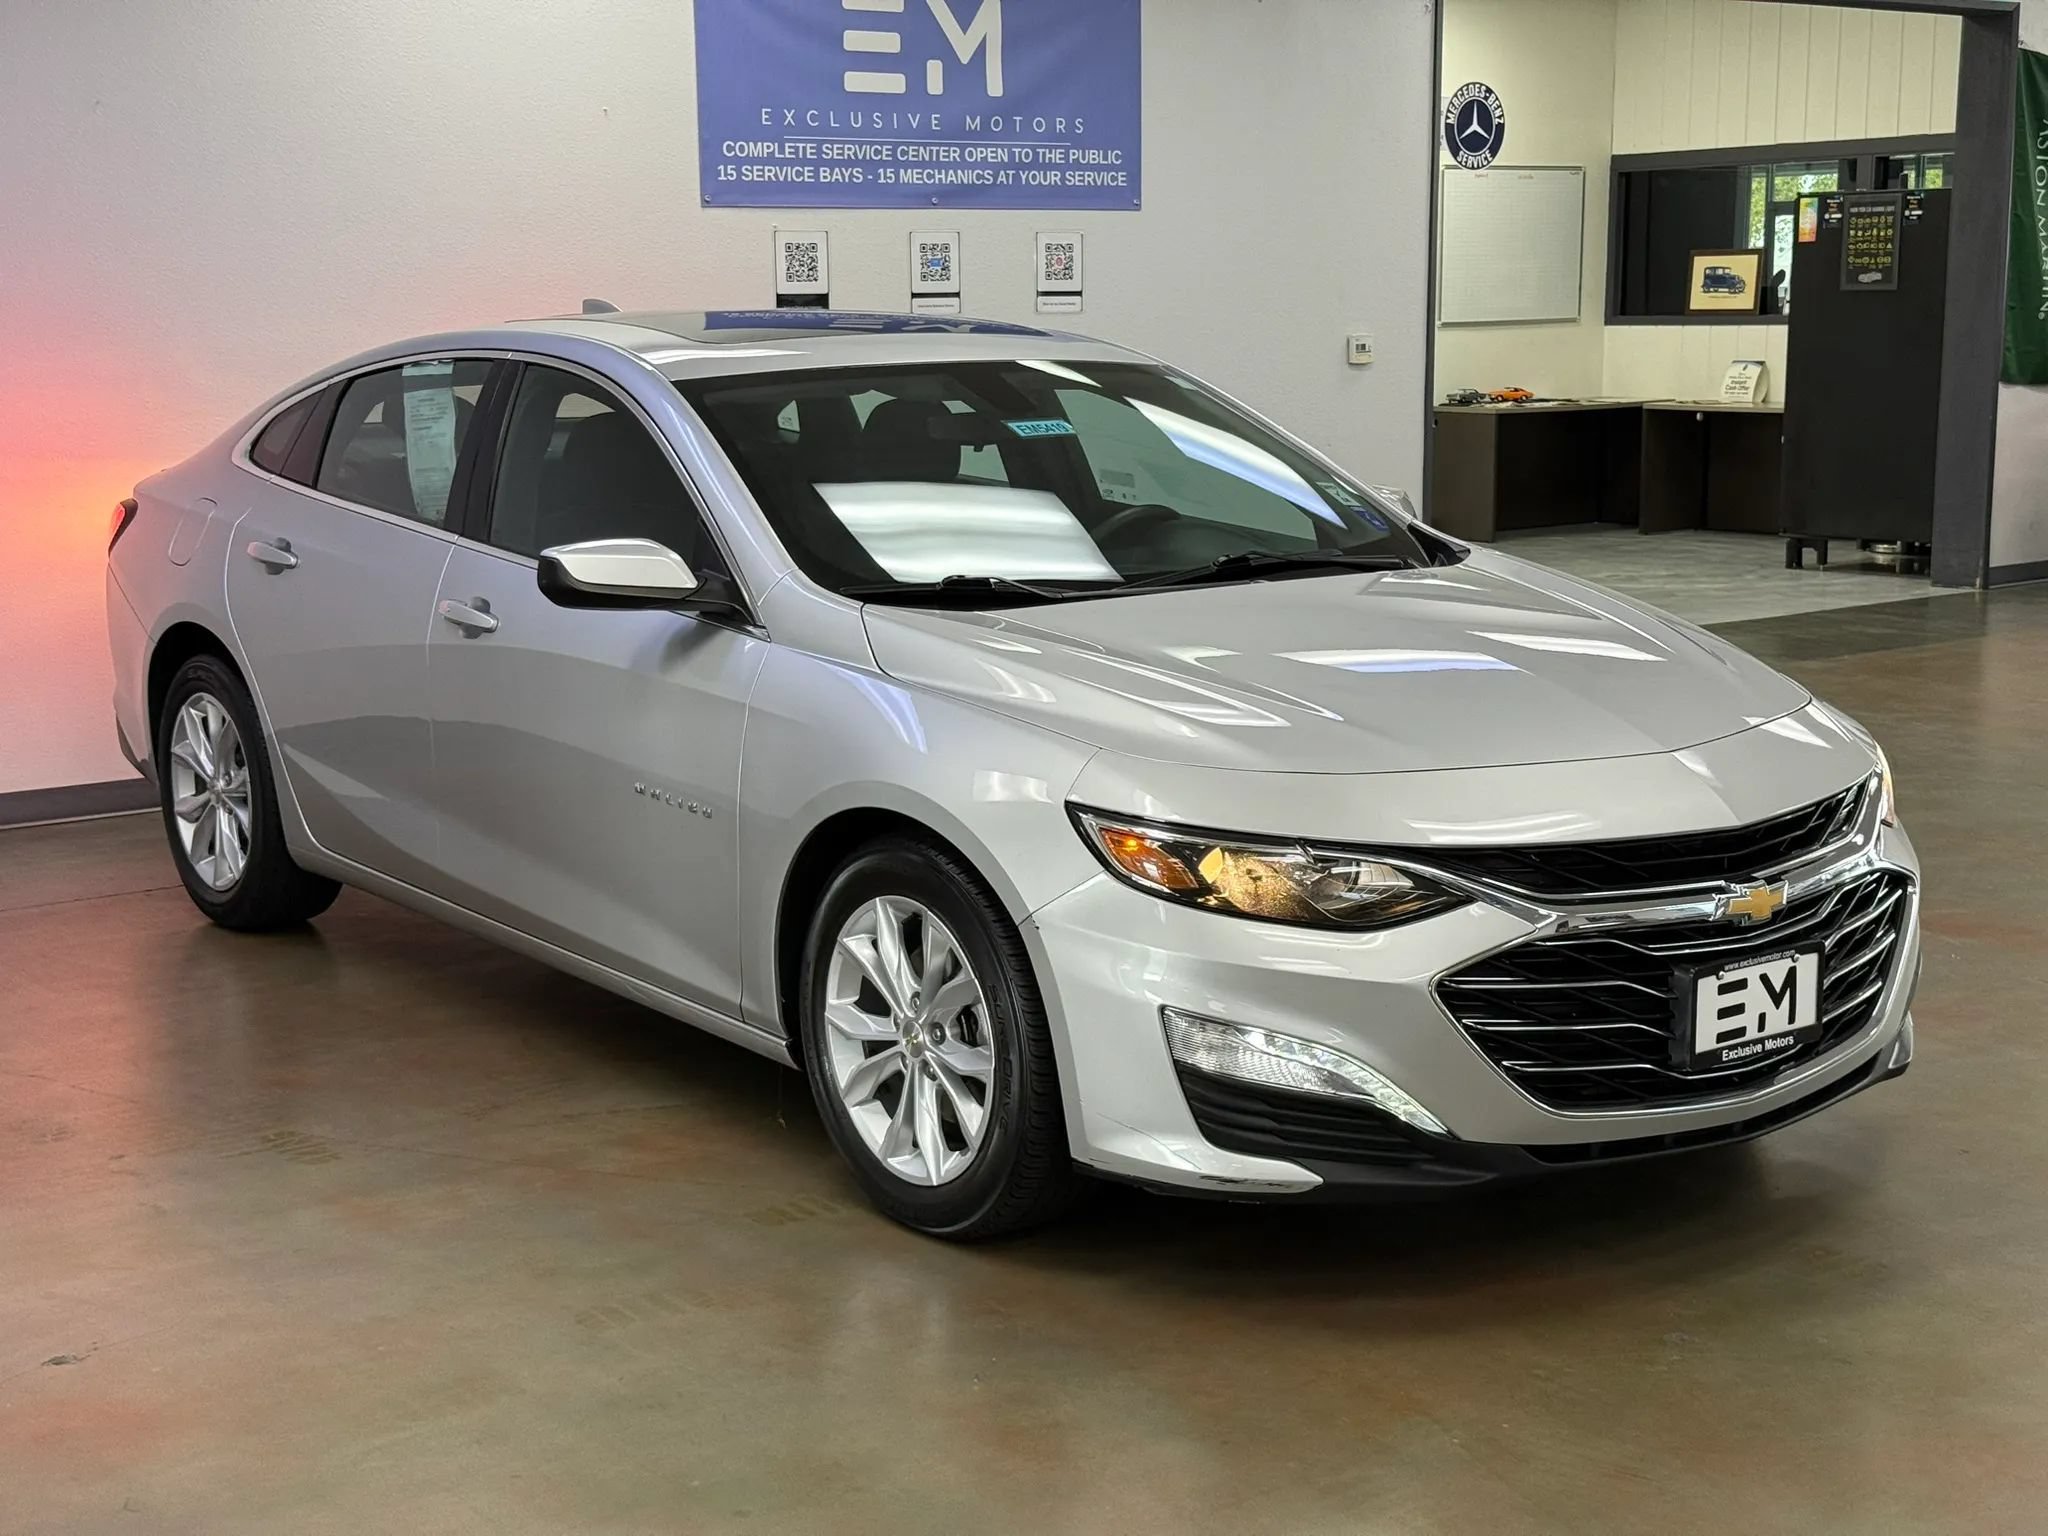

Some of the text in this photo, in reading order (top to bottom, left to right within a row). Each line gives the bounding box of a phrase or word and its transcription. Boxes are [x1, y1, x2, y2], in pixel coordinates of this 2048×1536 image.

[1445, 83, 1504, 125] MERCEDES-BENZ
[761, 108, 1084, 134] EXCLUSIVE MOTORS
[722, 141, 1122, 165] COMPLETE SERVICE CENTER OPEN TO THE PUBLIC
[1456, 149, 1493, 168] SERVICE
[717, 164, 737, 181] 15
[741, 166, 815, 183] SERVICE
[819, 167, 864, 183] BAYS
[877, 168, 896, 184] 15
[899, 169, 994, 185] MECHANICS
[996, 170, 1015, 185] AT
[1018, 171, 1062, 186] YOUR
[1065, 171, 1128, 187] SERVICE
[1715, 965, 1797, 1044] EM
[1721, 1035, 1794, 1061] Exclusive Motors
